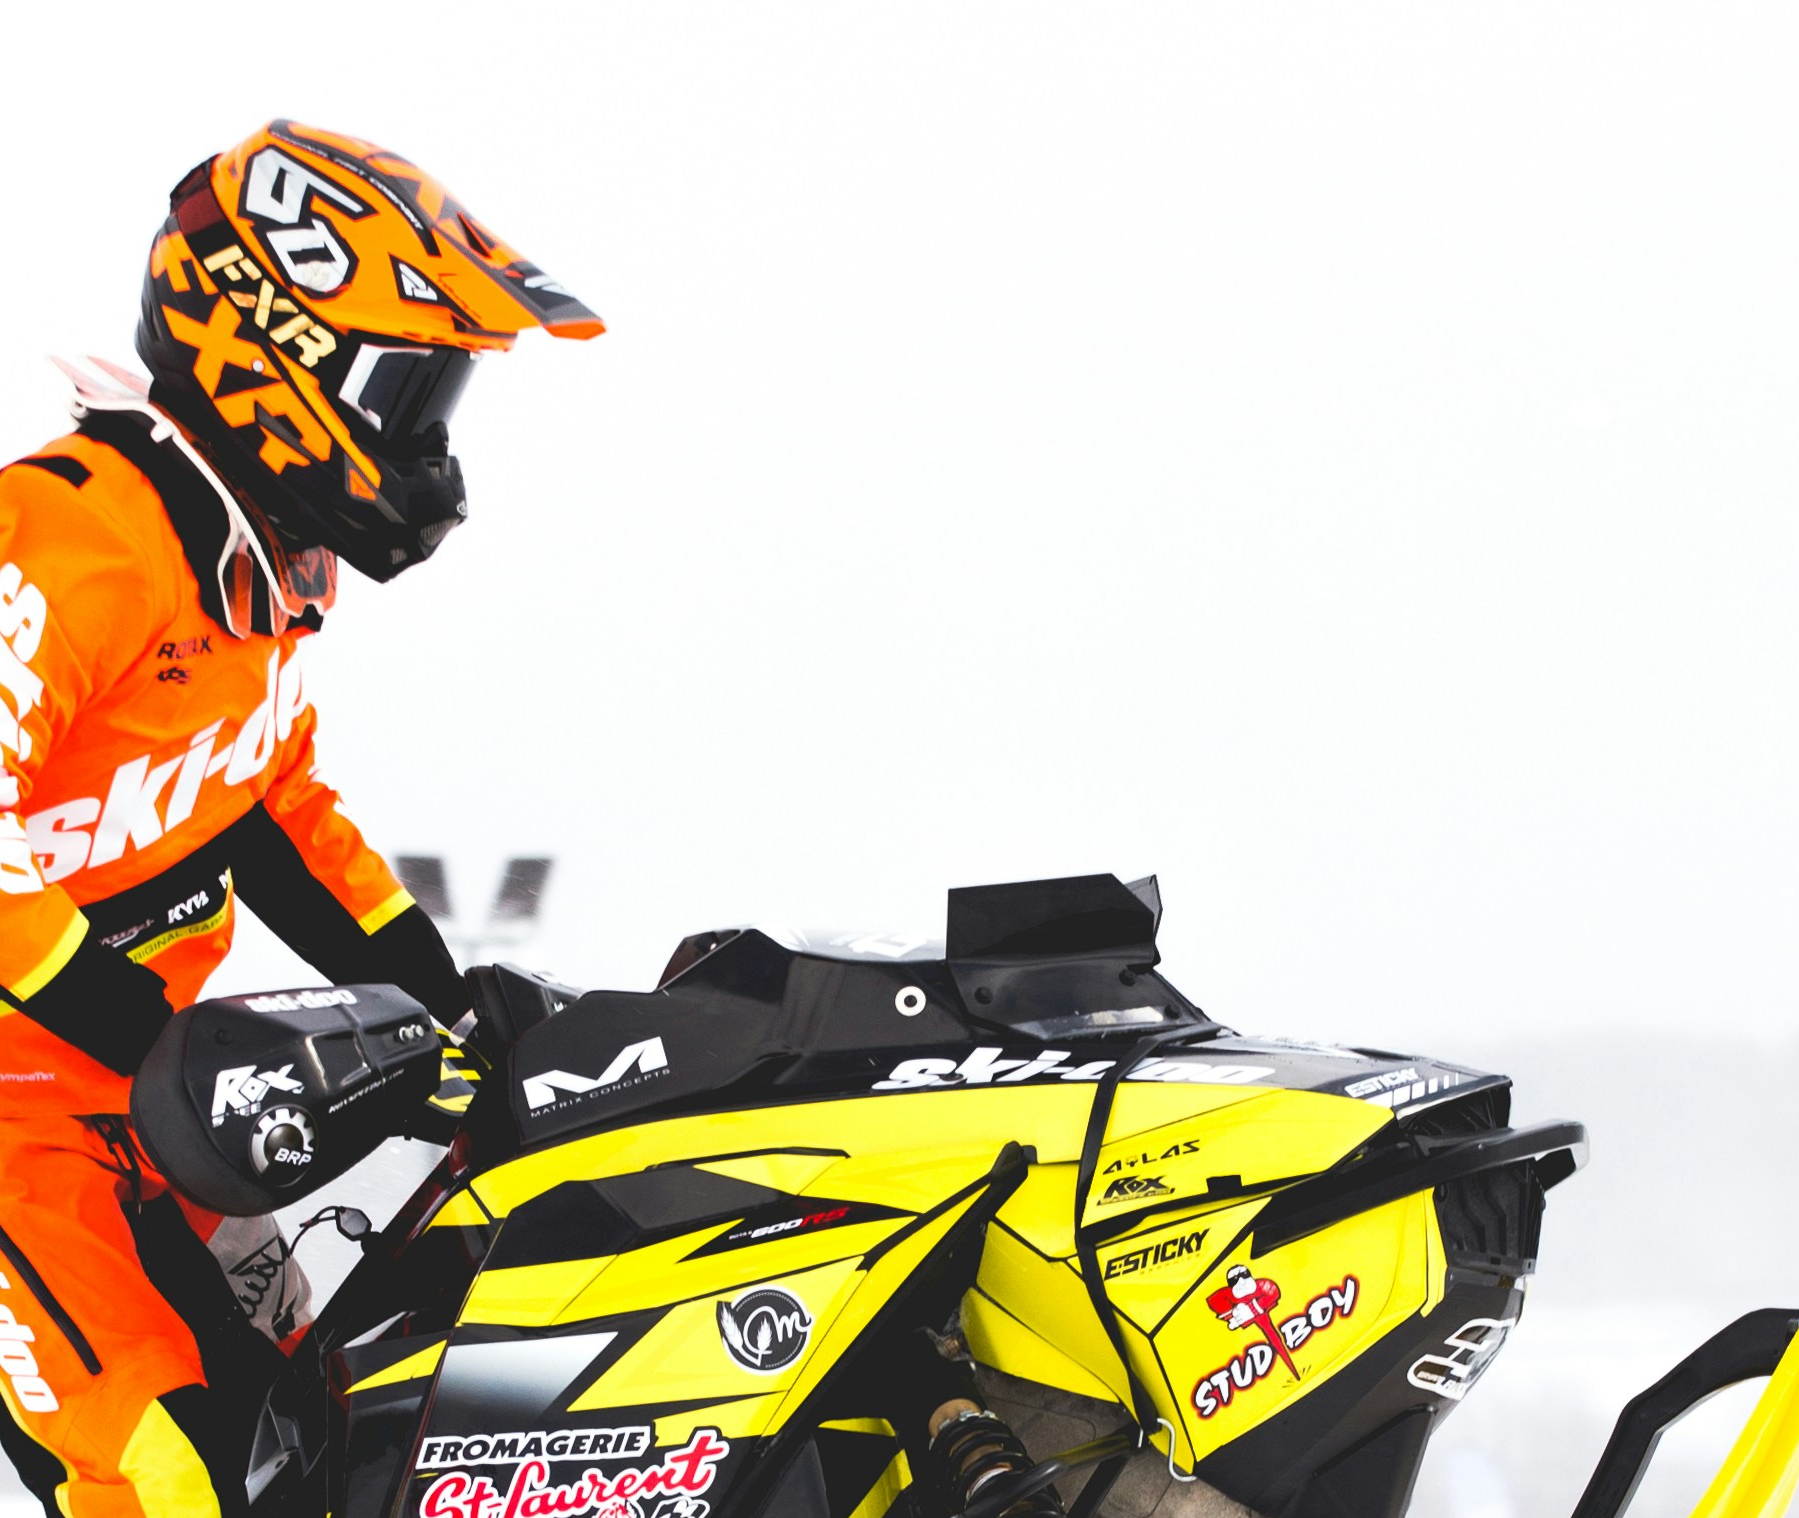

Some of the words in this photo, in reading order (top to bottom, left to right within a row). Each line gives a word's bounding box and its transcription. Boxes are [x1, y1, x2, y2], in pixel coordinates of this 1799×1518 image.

[203, 244, 338, 369] FXR
[133, 929, 183, 963] RIGINAL
[531, 1097, 583, 1118] MATRIX
[589, 1069, 671, 1099] CONCEPTS
[274, 1147, 312, 1166] BRP
[1193, 1344, 1274, 1418] STUD
[1280, 1277, 1357, 1351] BOY
[422, 1431, 645, 1464] FROMAGERIE
